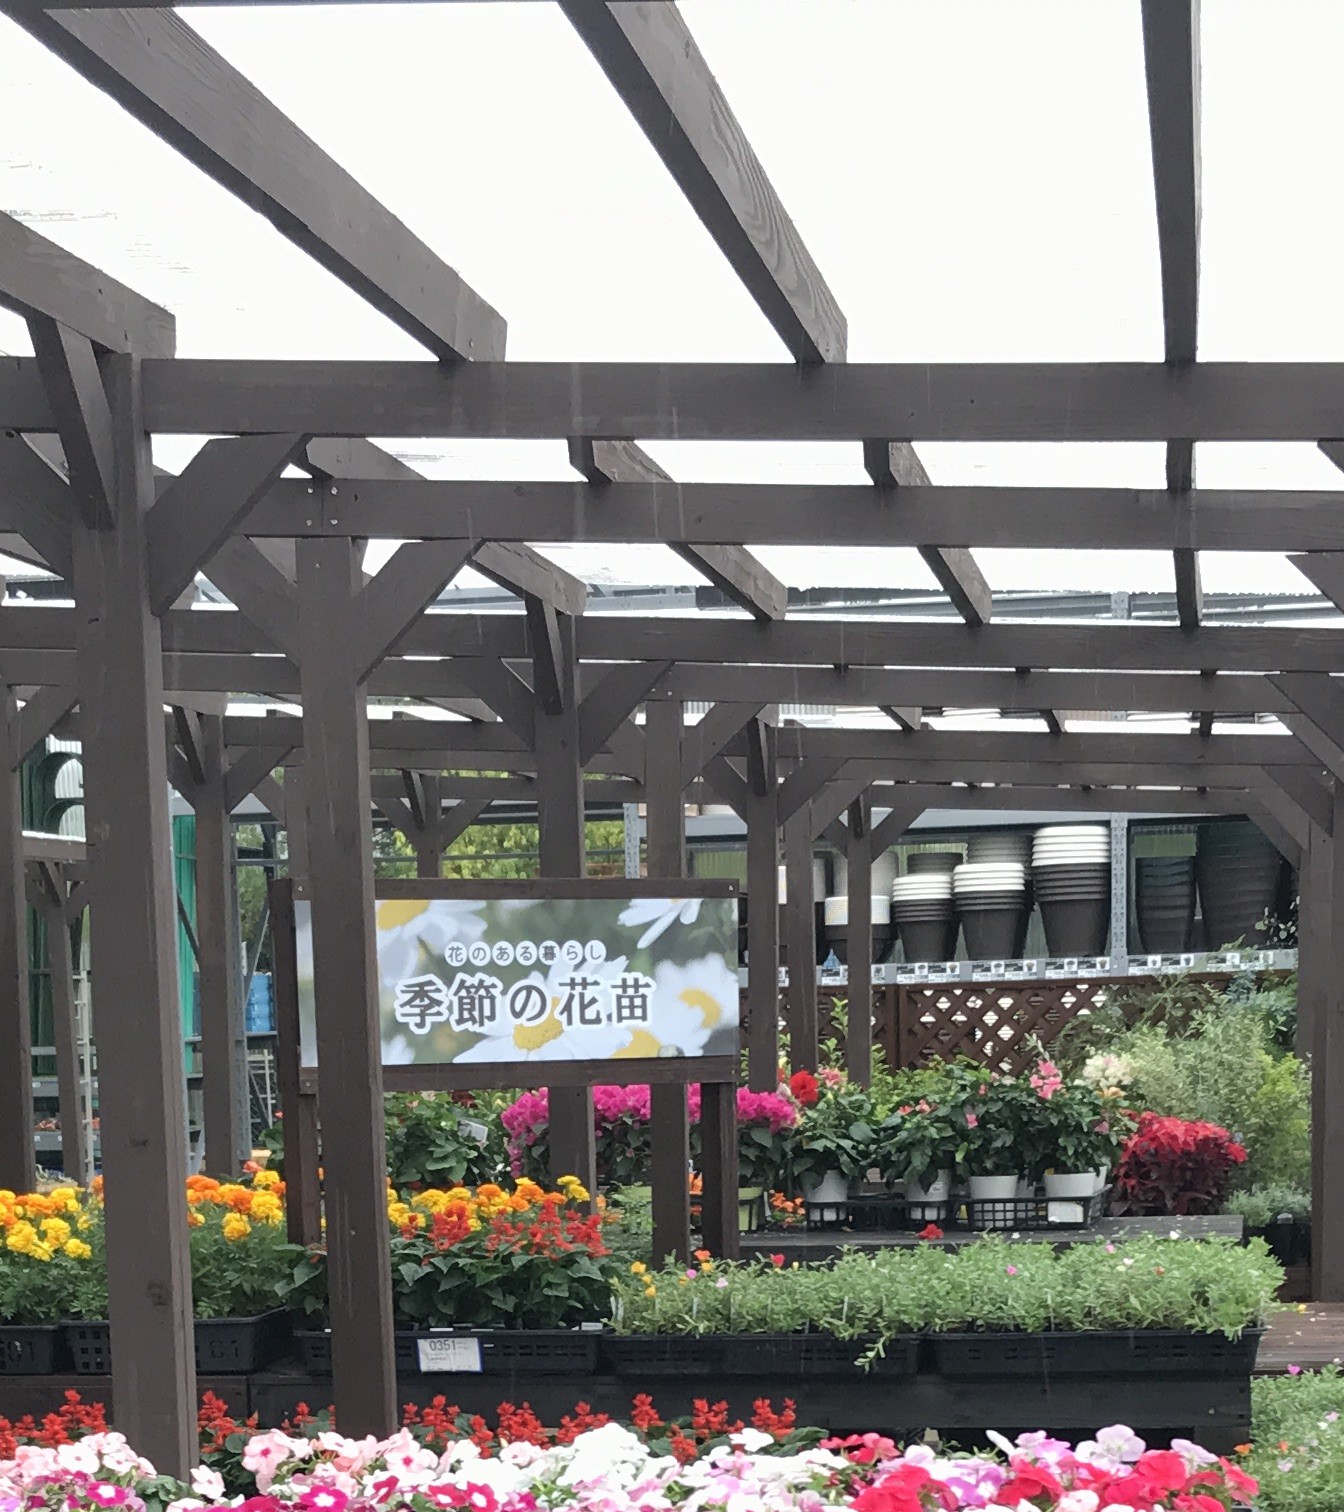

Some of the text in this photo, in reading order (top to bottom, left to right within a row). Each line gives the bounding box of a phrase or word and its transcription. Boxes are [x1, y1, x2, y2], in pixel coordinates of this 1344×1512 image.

[446, 943, 604, 964] 花のある暮らし
[398, 976, 653, 1029] 季節の花苗
[428, 1339, 456, 1352] 0351
